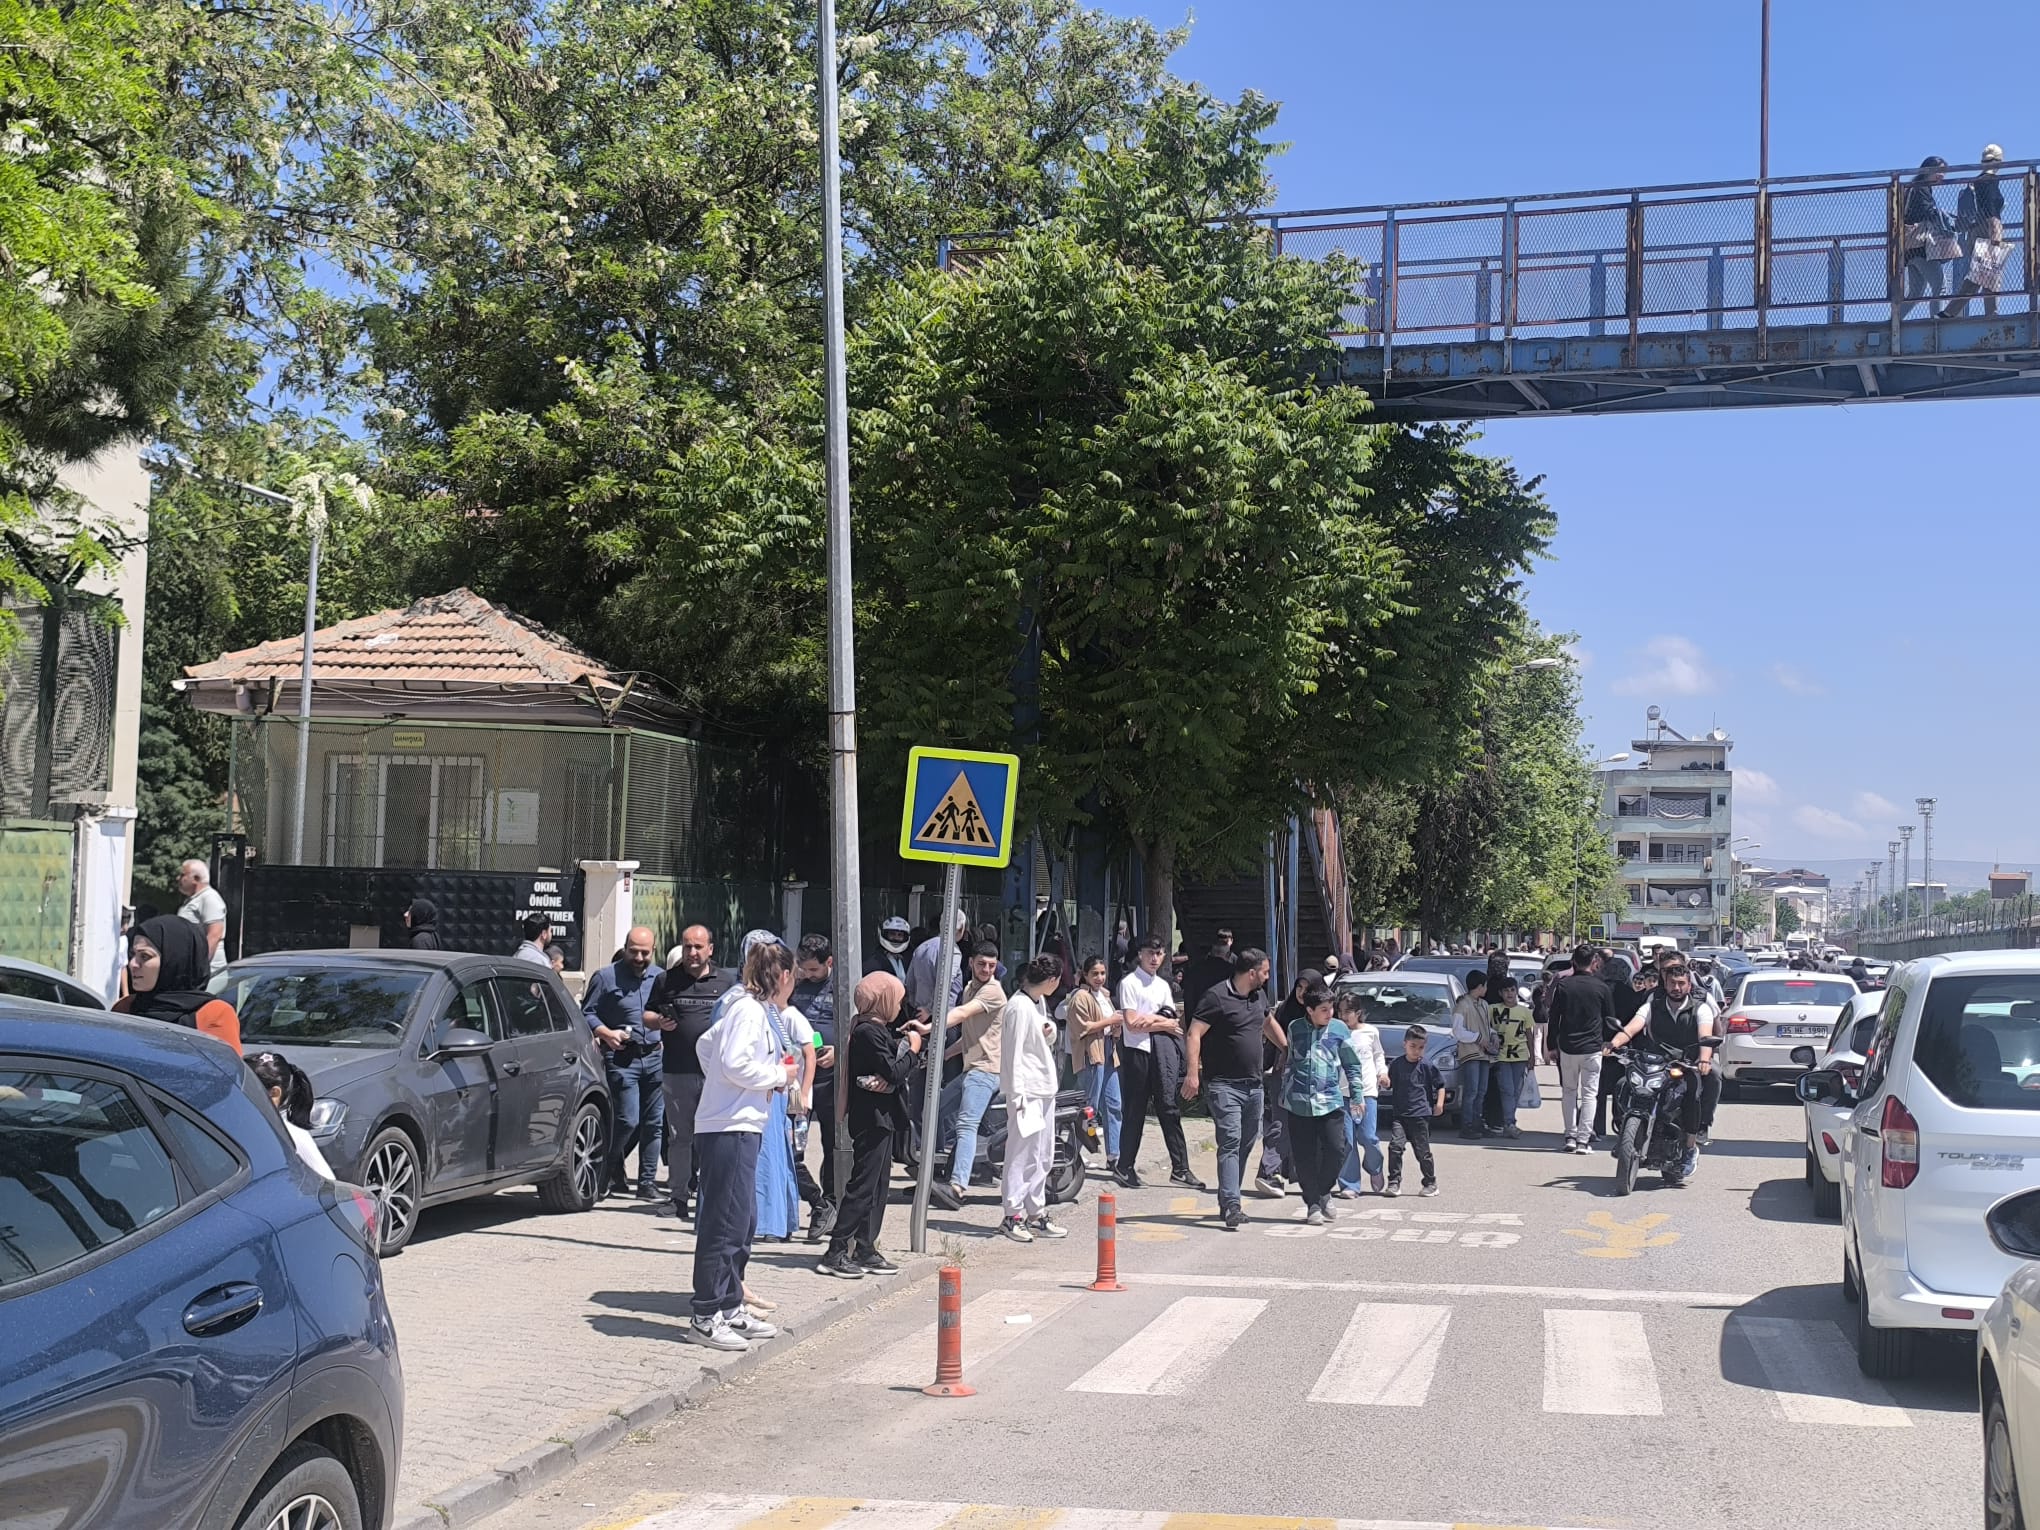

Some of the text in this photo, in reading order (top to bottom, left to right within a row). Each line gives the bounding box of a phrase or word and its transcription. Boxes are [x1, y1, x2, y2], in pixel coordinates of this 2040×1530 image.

[534, 881, 558, 893] OKUL
[529, 894, 562, 907] ÖNÜNE
[516, 910, 541, 920] PA
